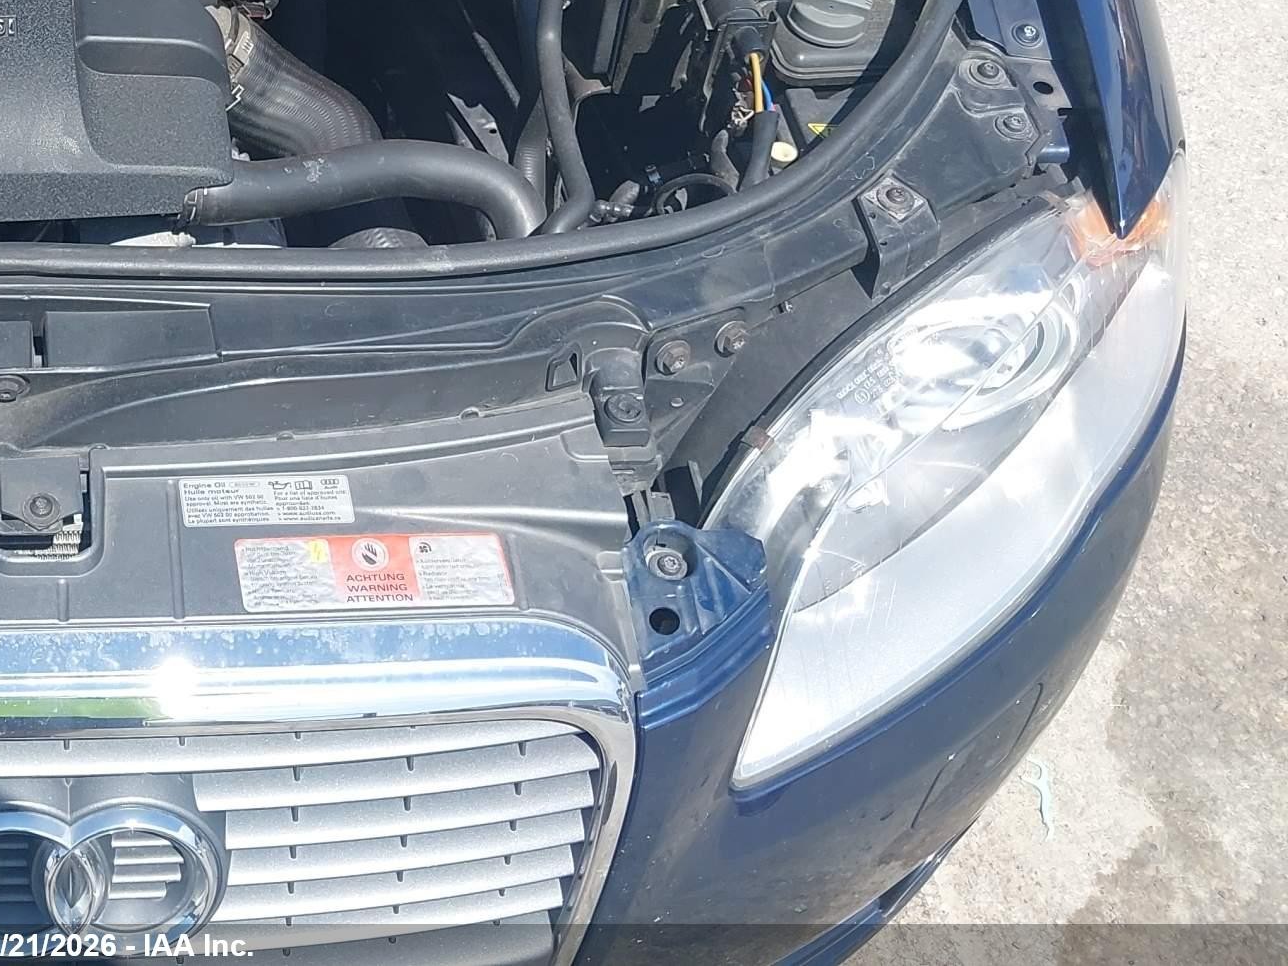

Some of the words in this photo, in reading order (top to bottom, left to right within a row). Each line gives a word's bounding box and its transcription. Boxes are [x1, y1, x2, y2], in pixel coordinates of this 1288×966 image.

[184, 482, 212, 490] Engine
[346, 574, 405, 582] ACHTUNG
[347, 584, 408, 592] WARNING
[346, 593, 414, 602] ATTENTION
